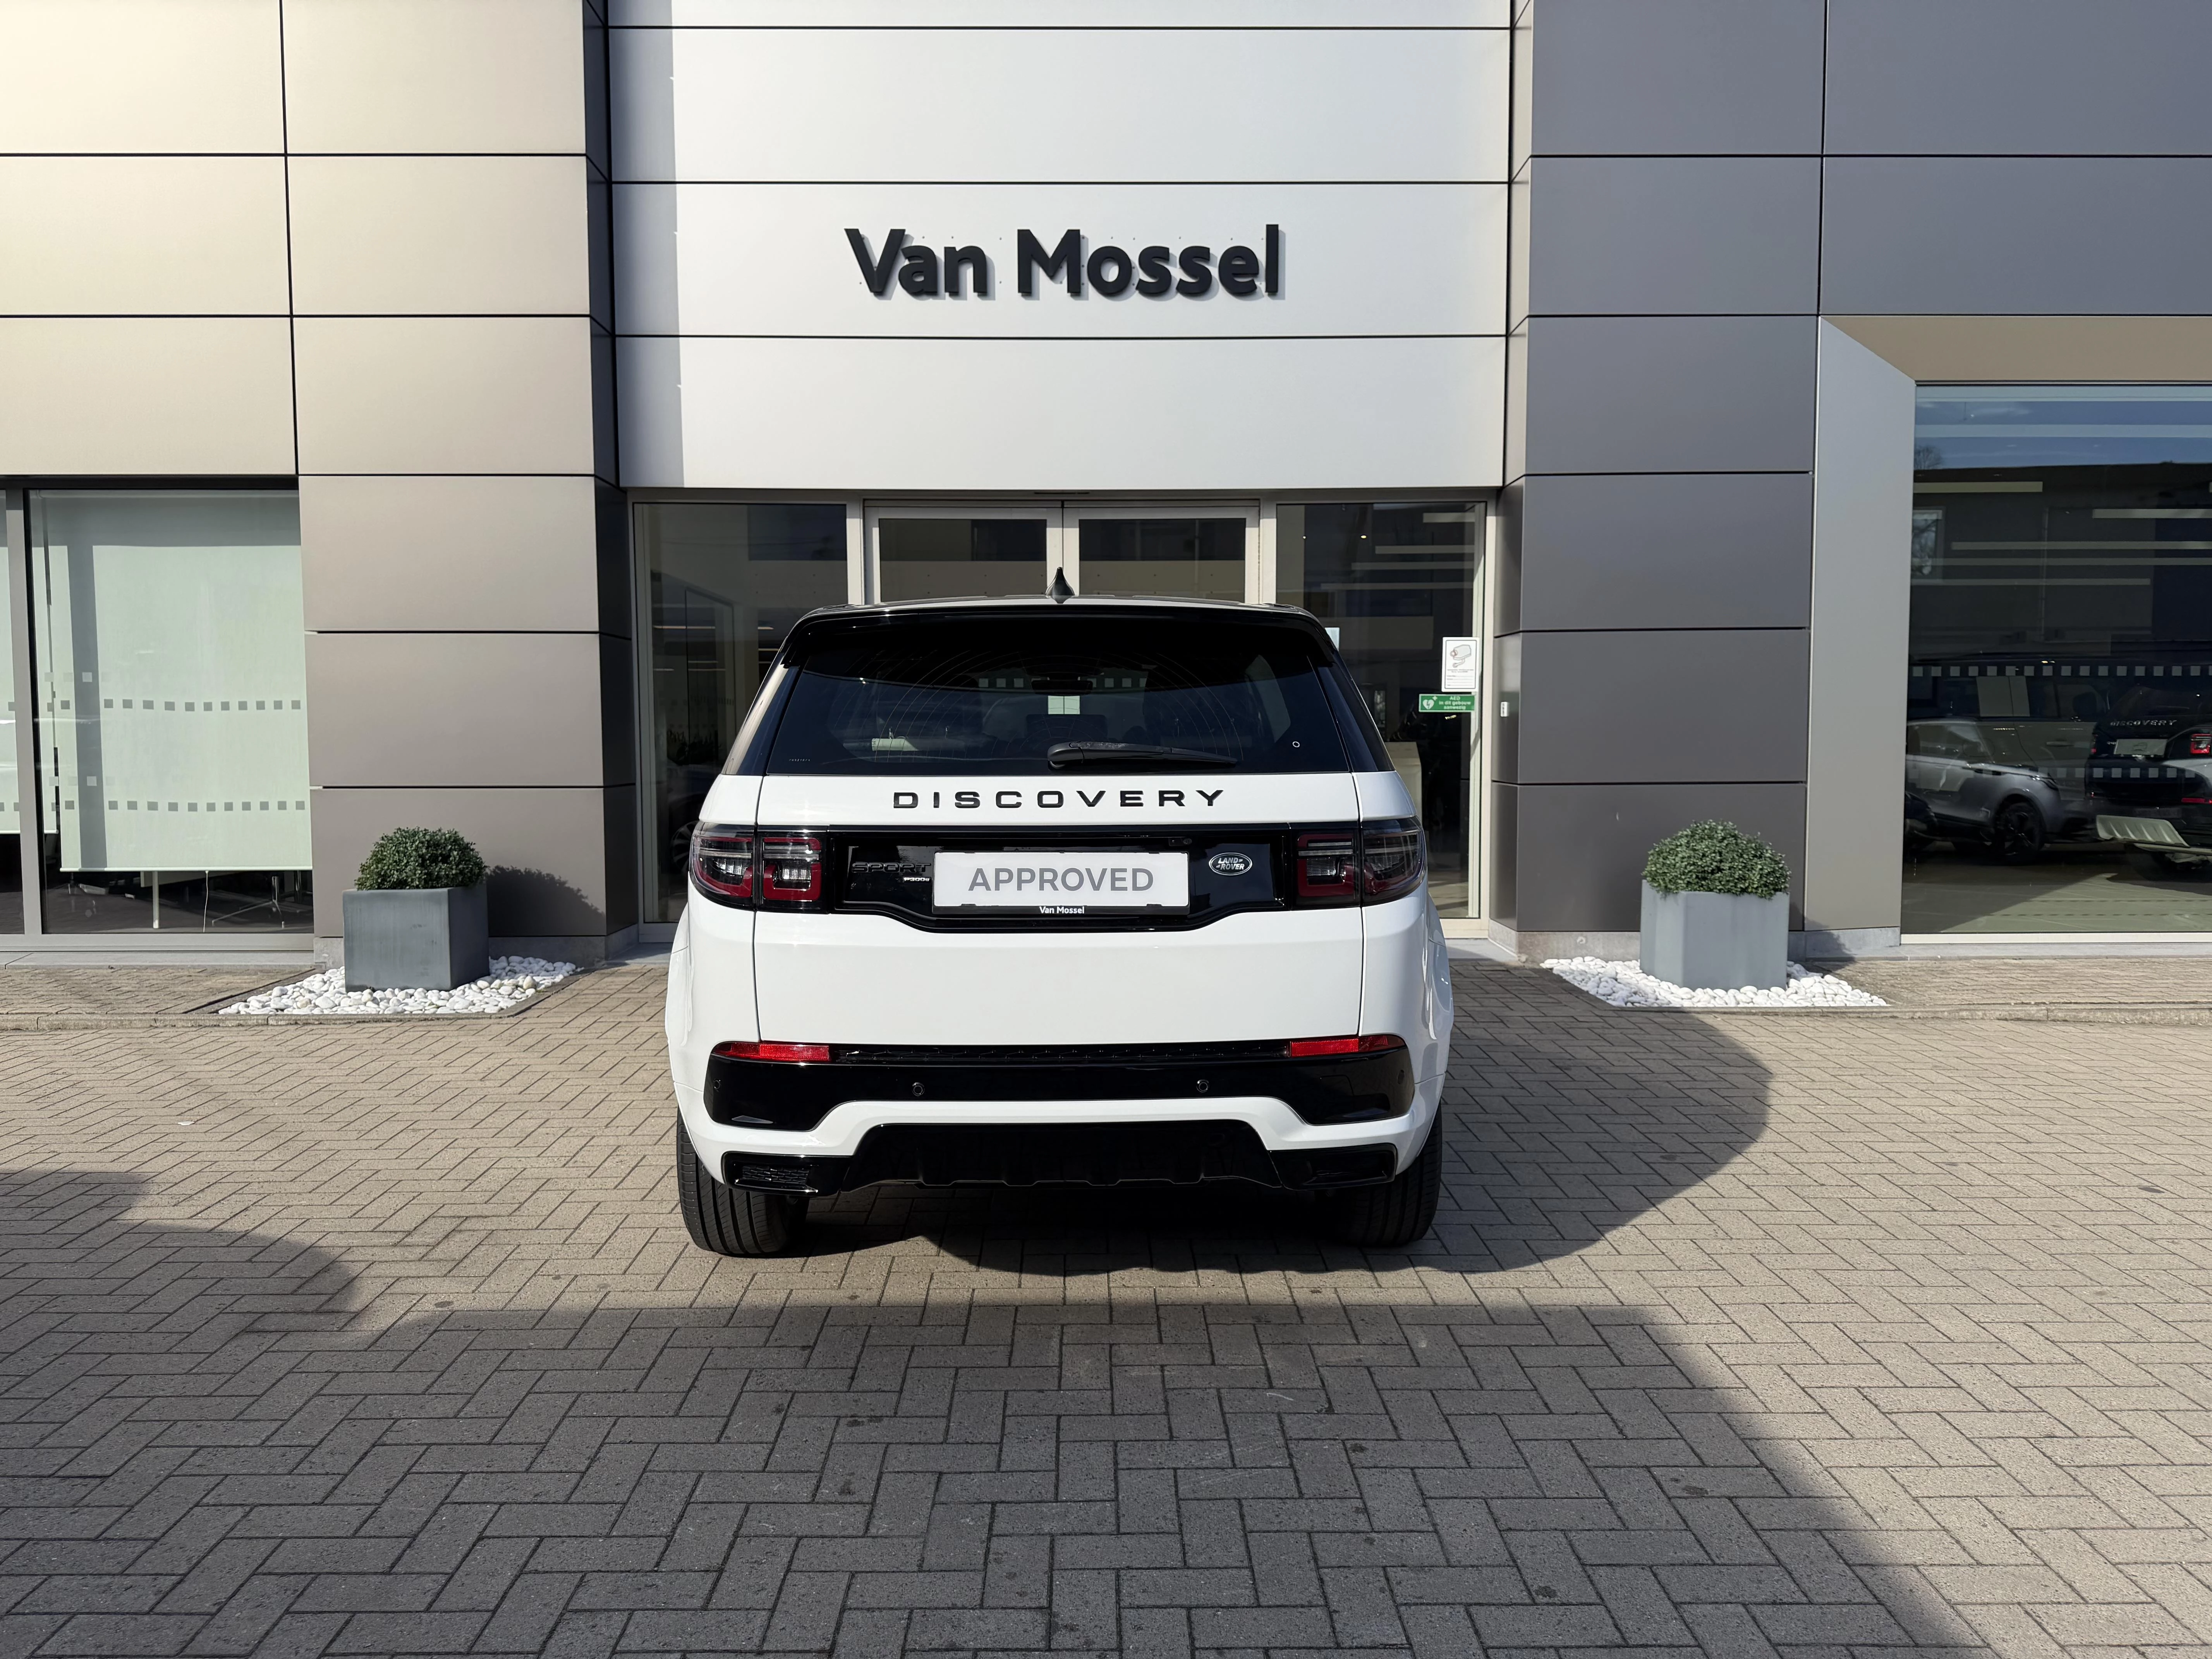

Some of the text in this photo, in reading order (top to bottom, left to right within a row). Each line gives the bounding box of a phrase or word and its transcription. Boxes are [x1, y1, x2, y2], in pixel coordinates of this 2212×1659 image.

[844, 223, 1279, 296] Van Mossel
[893, 790, 1224, 809] DISCOVERY
[852, 862, 931, 872] SPORT
[968, 868, 1153, 891] APPROVED
